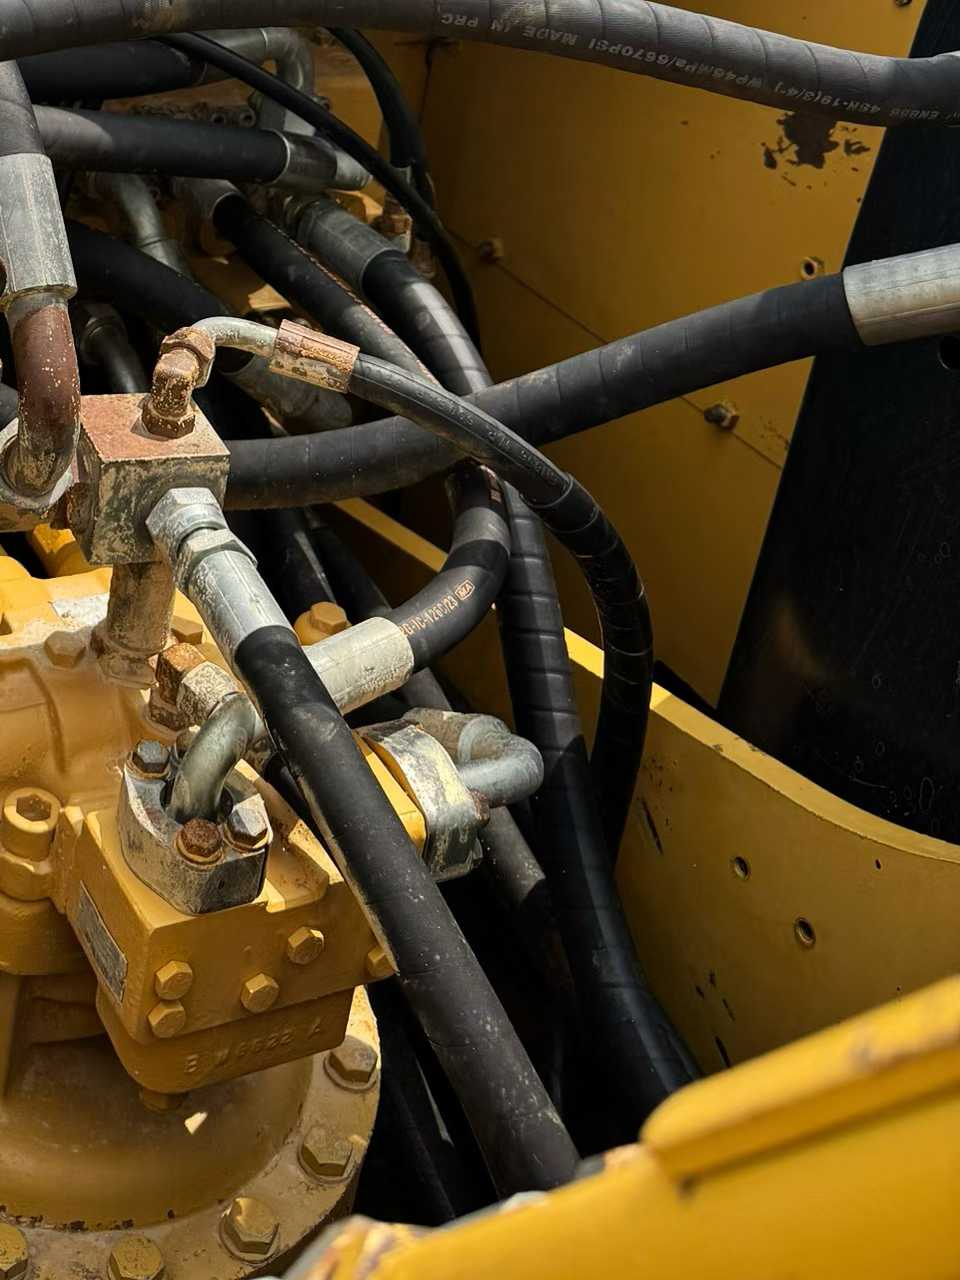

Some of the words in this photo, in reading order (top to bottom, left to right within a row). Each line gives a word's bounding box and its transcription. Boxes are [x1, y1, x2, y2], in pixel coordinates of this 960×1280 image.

[440, 13, 480, 29] PRC
[489, 19, 515, 34] IN
[522, 24, 579, 46] MADE
